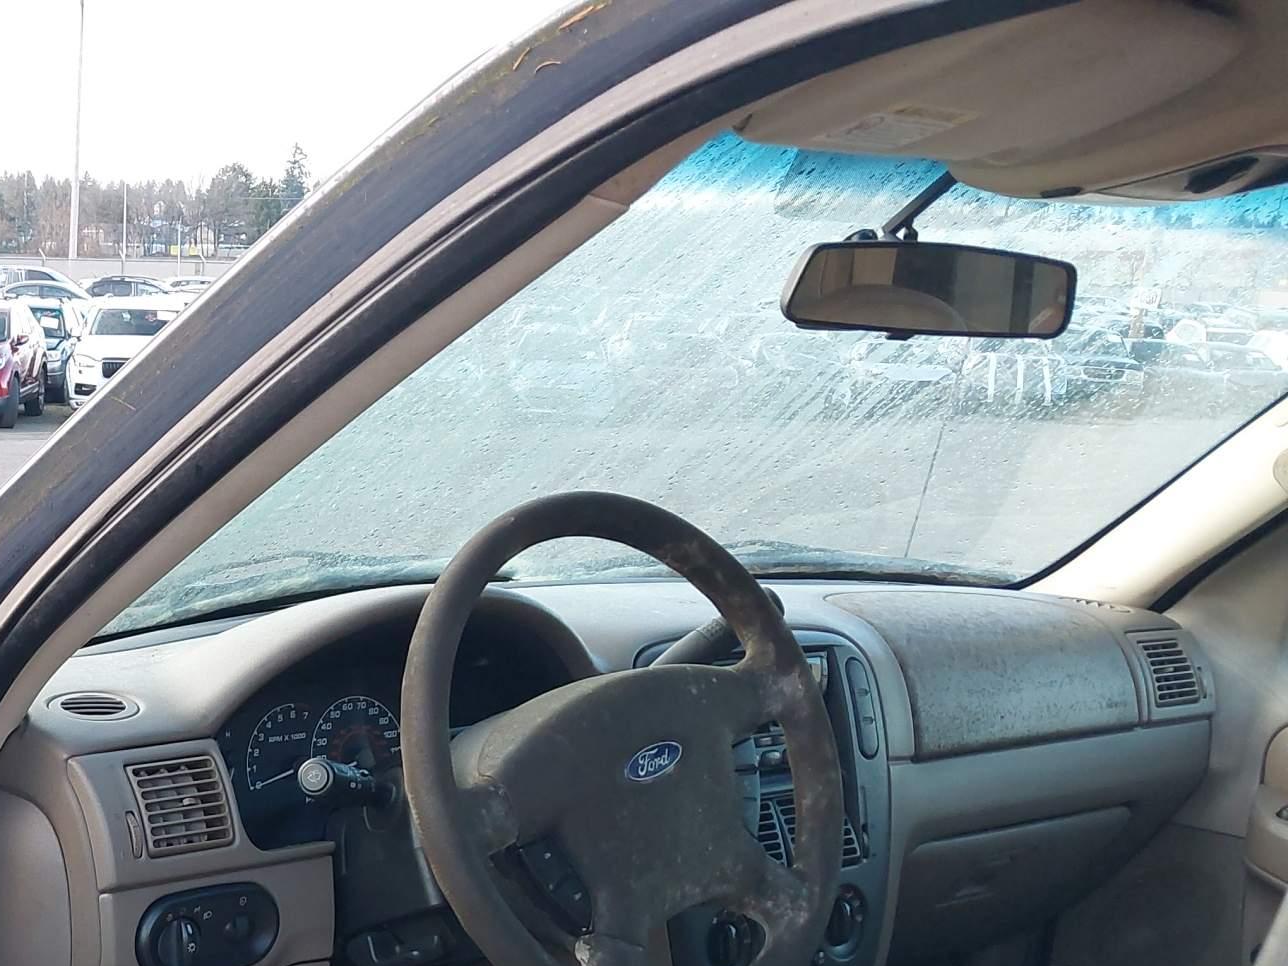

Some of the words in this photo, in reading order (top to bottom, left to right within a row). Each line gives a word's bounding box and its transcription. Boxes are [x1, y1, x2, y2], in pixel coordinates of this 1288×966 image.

[342, 703, 353, 711] 60
[357, 701, 367, 710] 70
[278, 714, 283, 722] 5
[290, 710, 296, 719] 6
[303, 711, 309, 719] 7
[320, 722, 332, 730] 40
[258, 733, 264, 741] 3
[316, 738, 328, 746] 30
[253, 748, 260, 757] 2
[638, 747, 671, 776] Ford
[253, 765, 257, 773] 1
